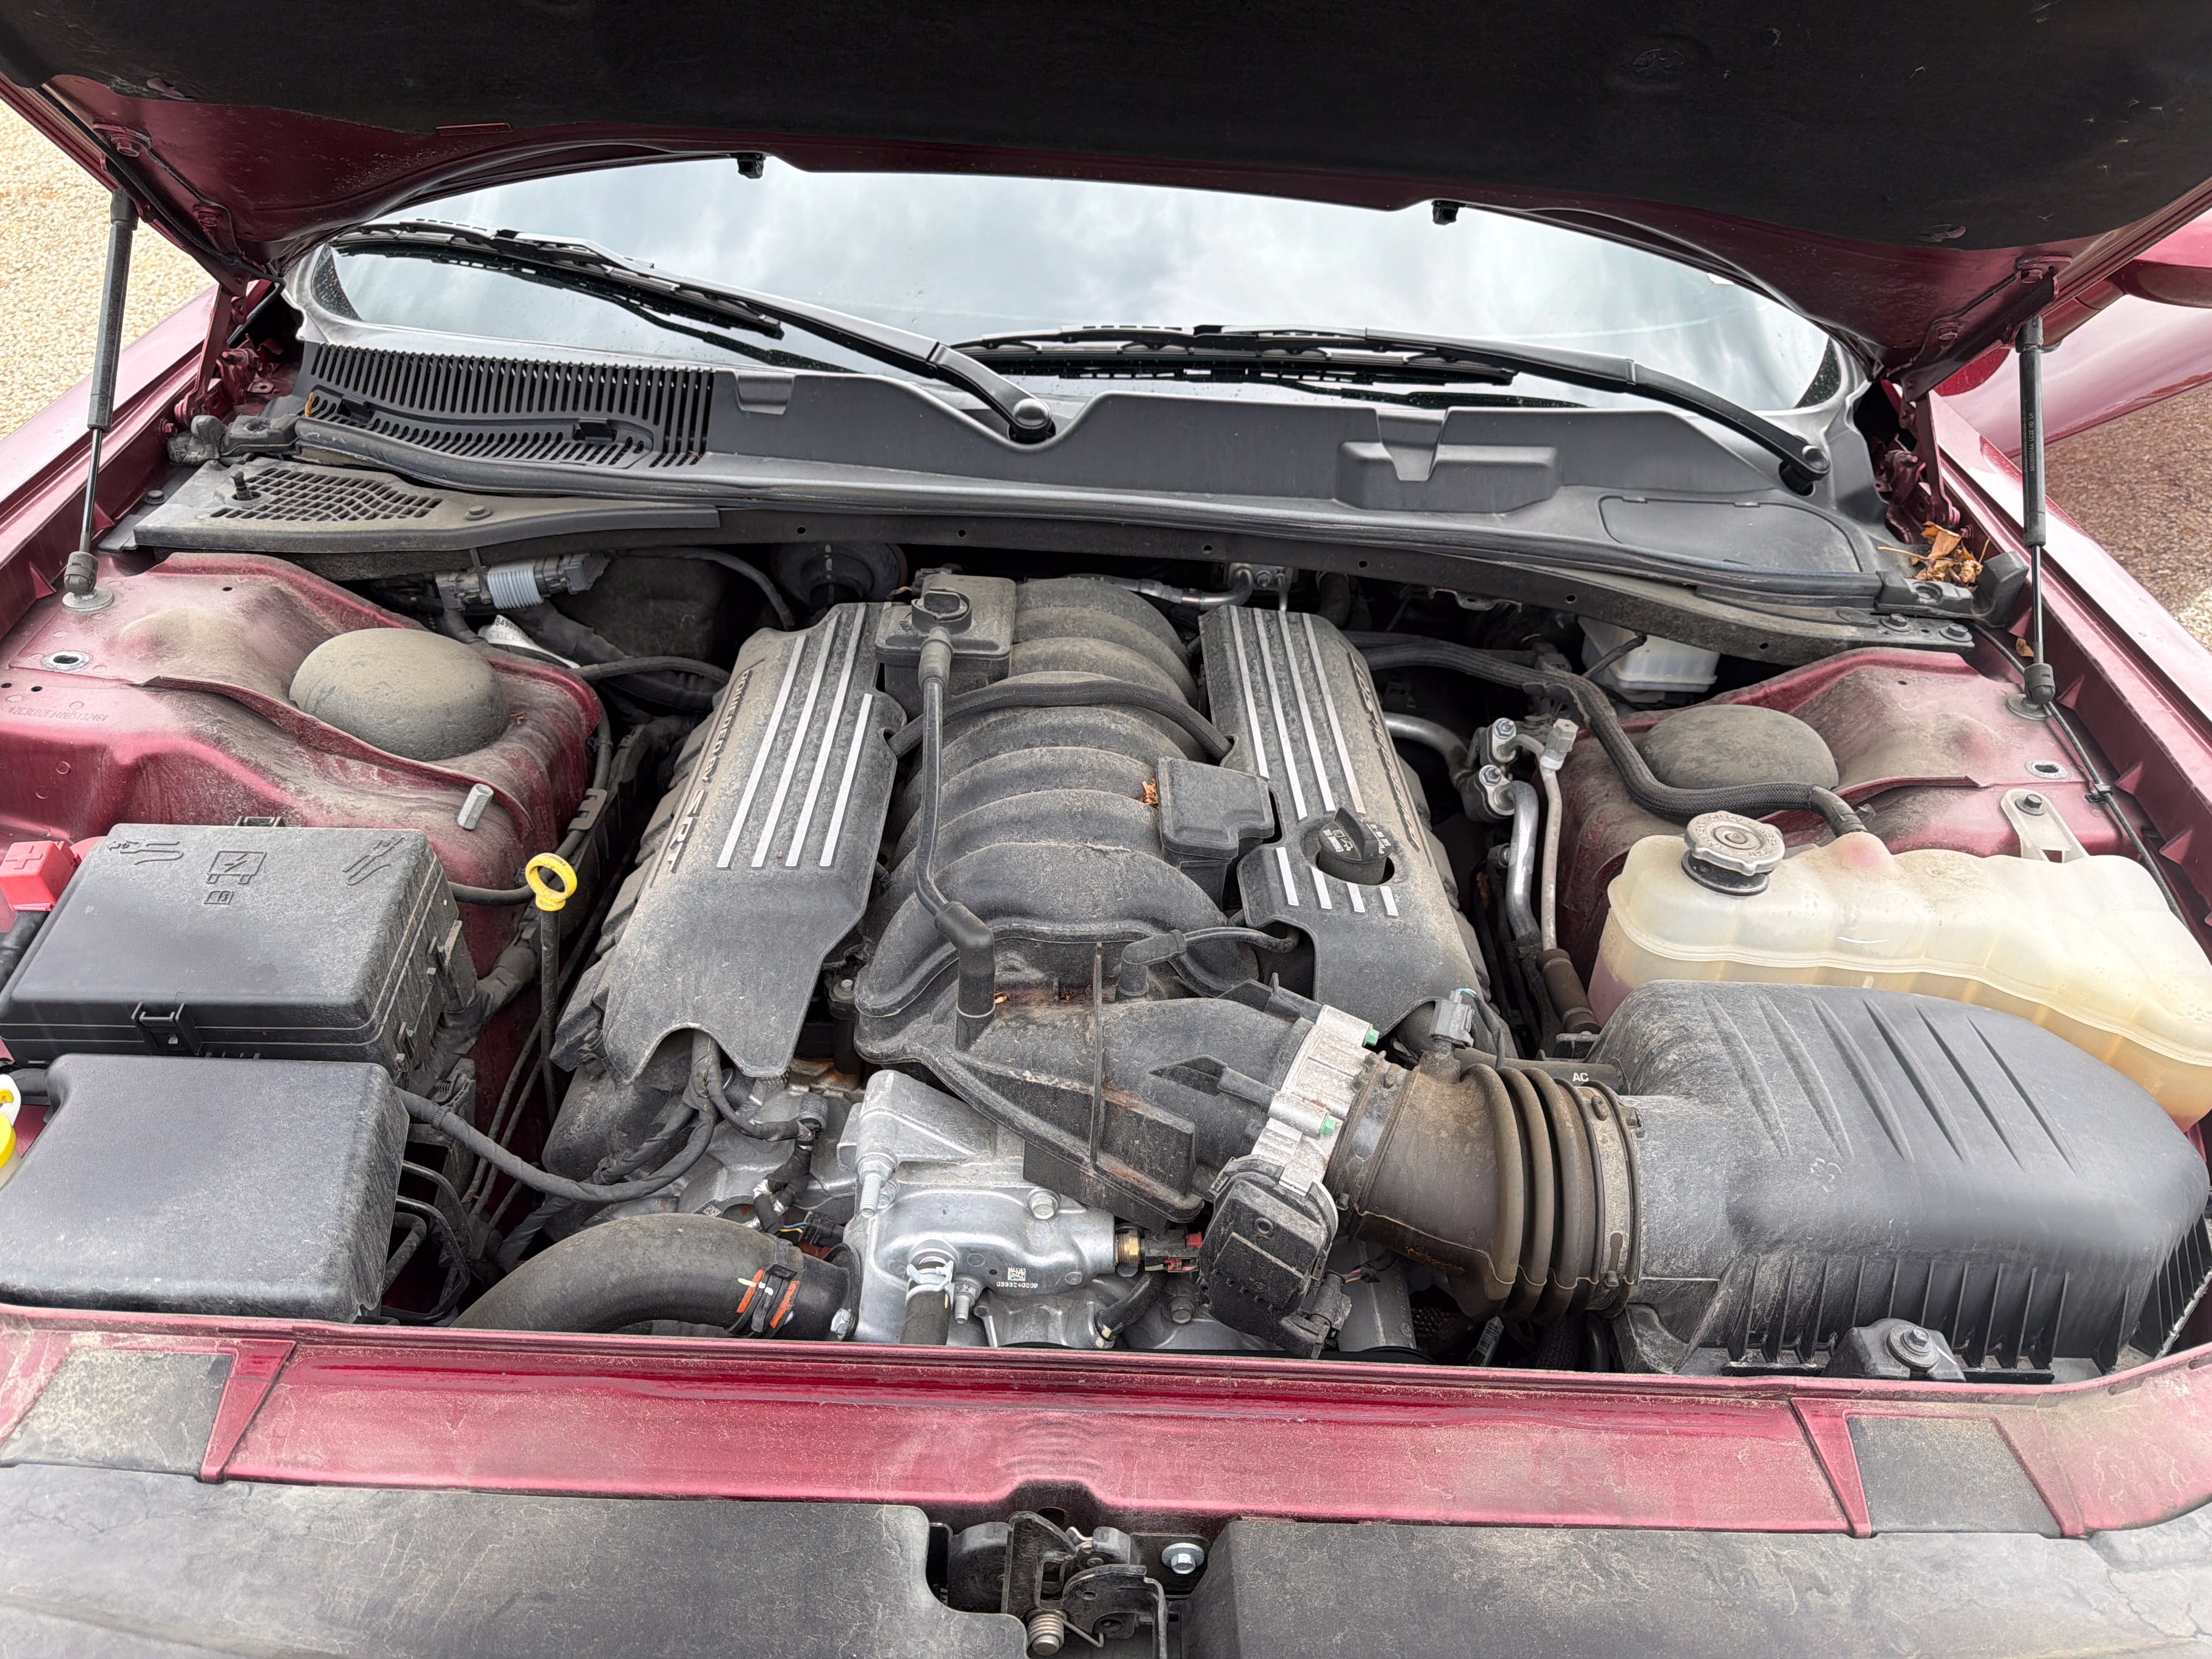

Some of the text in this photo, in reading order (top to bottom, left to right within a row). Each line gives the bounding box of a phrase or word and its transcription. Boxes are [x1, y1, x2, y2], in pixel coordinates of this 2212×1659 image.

[667, 669, 751, 871] POWERED BY SRT
[1327, 836, 1345, 853] ENGINE
[1572, 1072, 1589, 1082] AC
